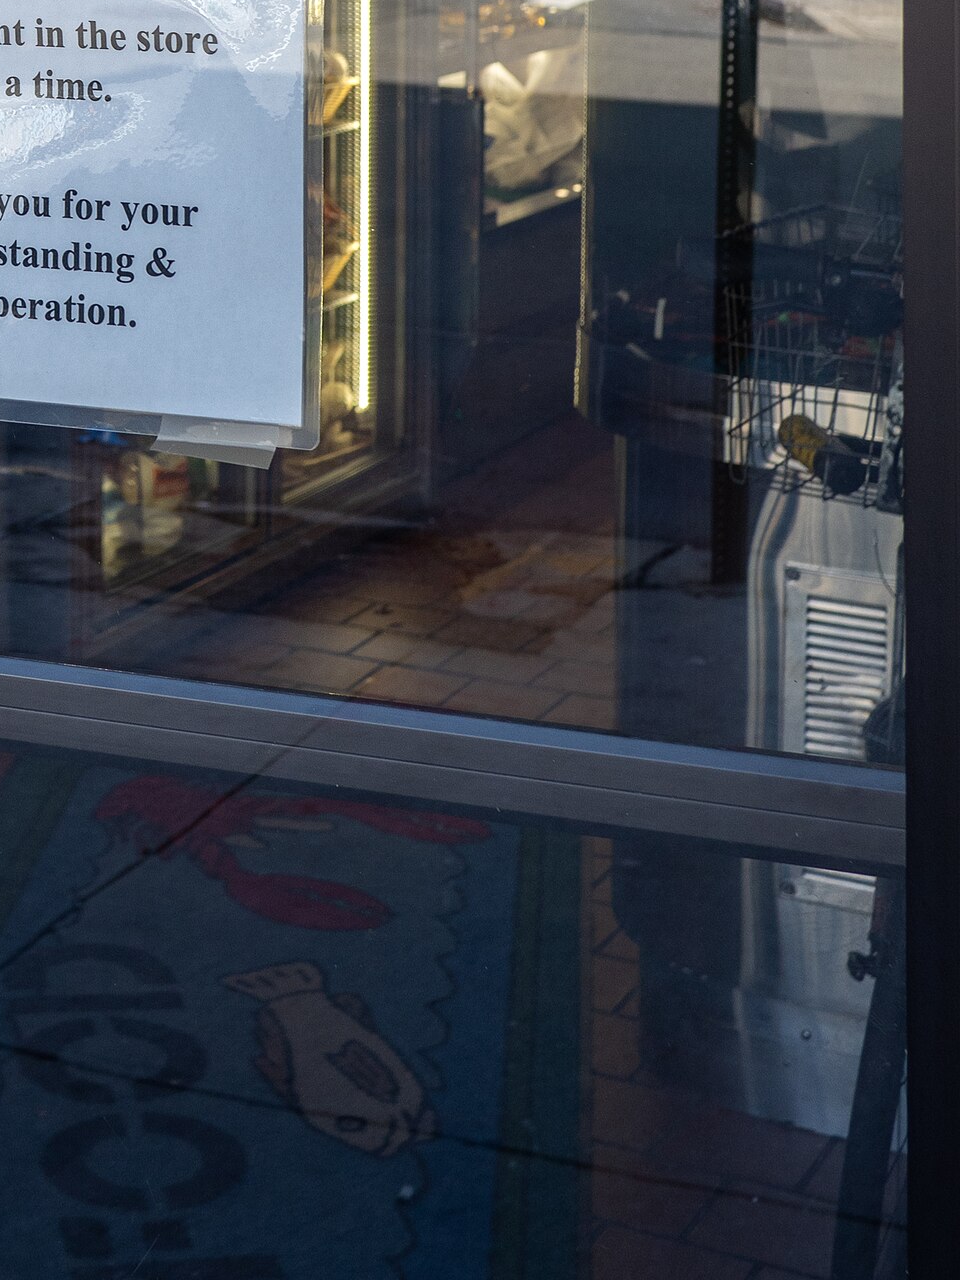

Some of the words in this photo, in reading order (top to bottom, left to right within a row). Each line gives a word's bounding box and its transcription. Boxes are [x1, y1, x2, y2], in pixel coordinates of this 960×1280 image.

[34, 18, 66, 48] in
[75, 22, 128, 53] the
[136, 27, 219, 56] store
[6, 78, 22, 99] a
[32, 70, 113, 104] time.
[62, 190, 111, 223] for
[120, 199, 199, 232] your
[145, 247, 177, 280] &
